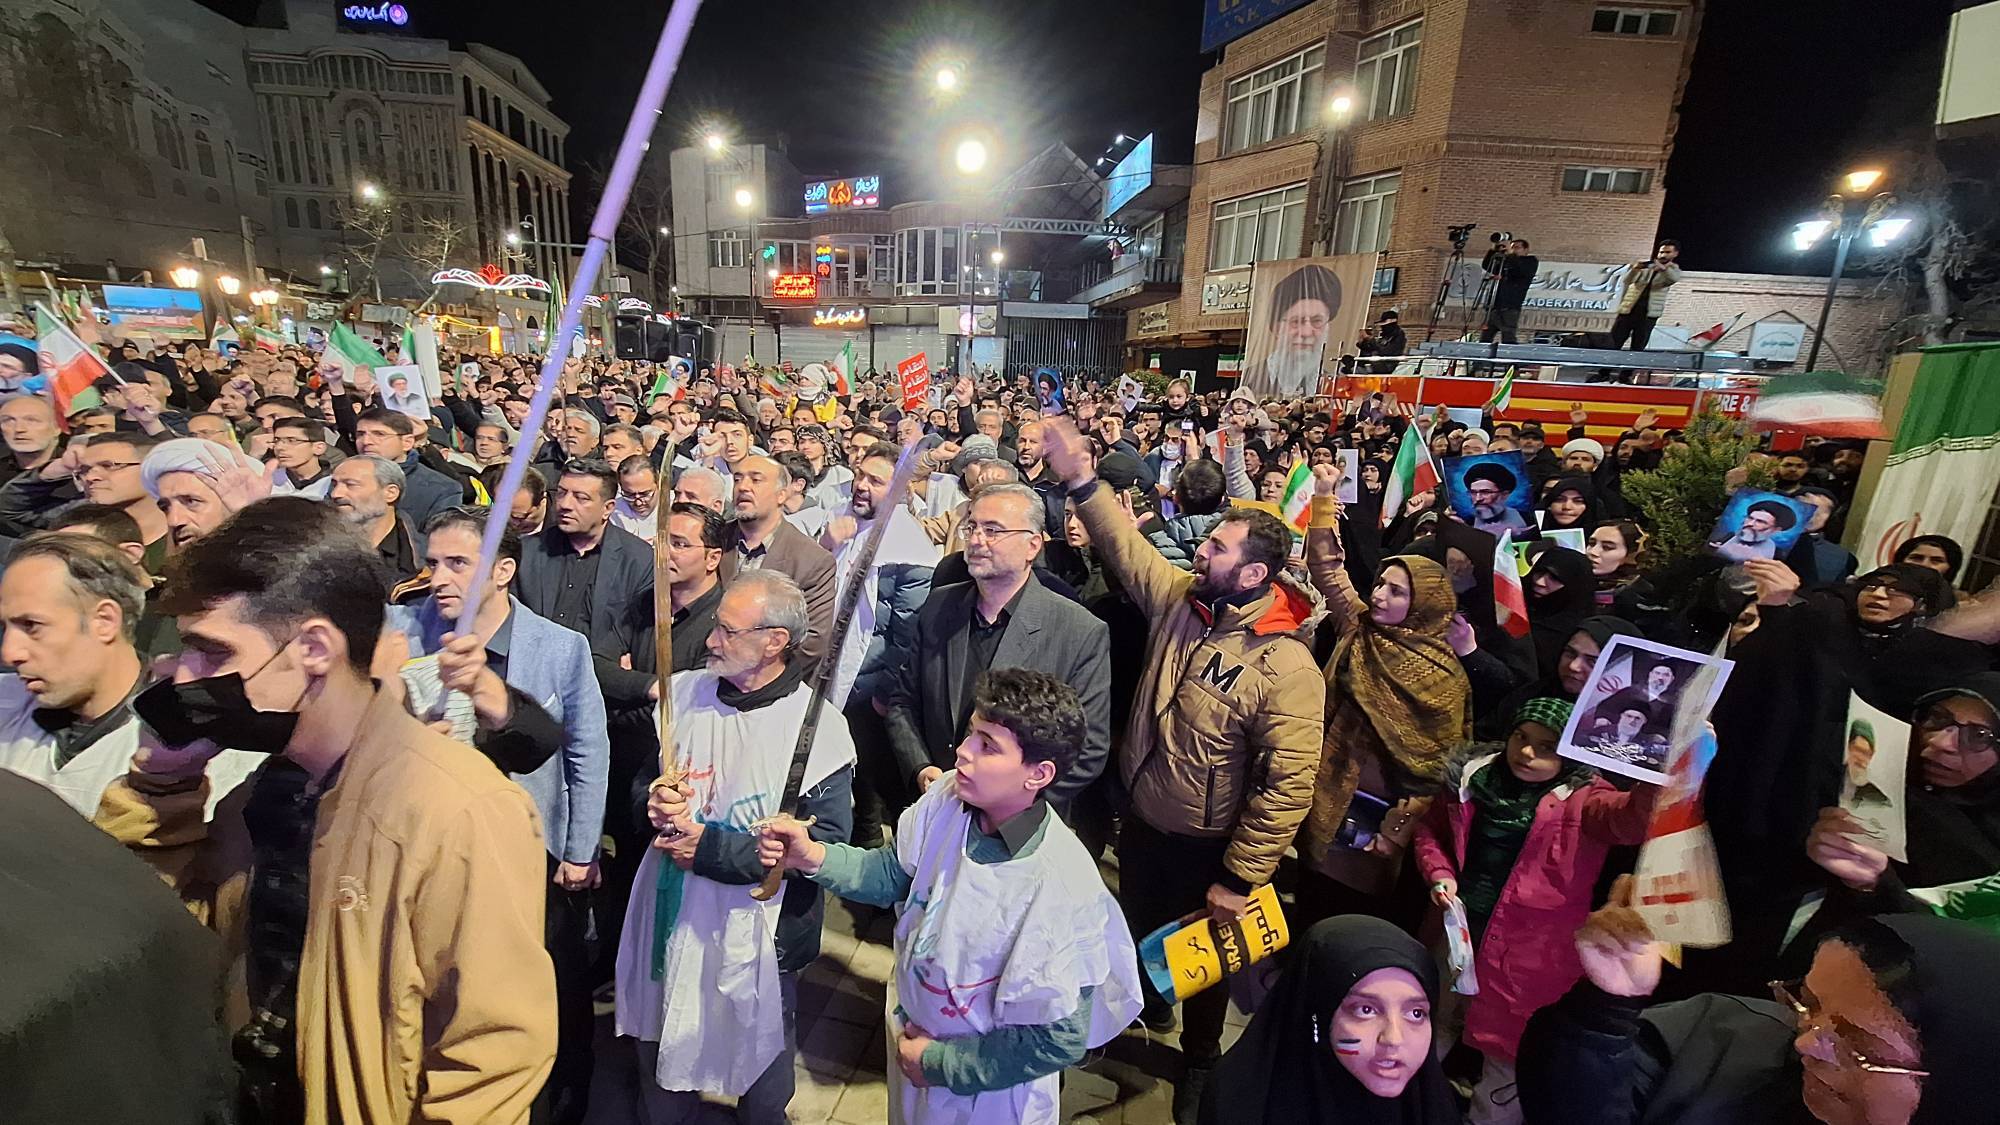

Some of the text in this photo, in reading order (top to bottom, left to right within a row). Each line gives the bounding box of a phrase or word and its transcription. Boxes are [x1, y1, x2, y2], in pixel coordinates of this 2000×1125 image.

[1580, 301, 1611, 309] IRAN
[1740, 394, 1751, 412] &
[1199, 650, 1246, 694] M
